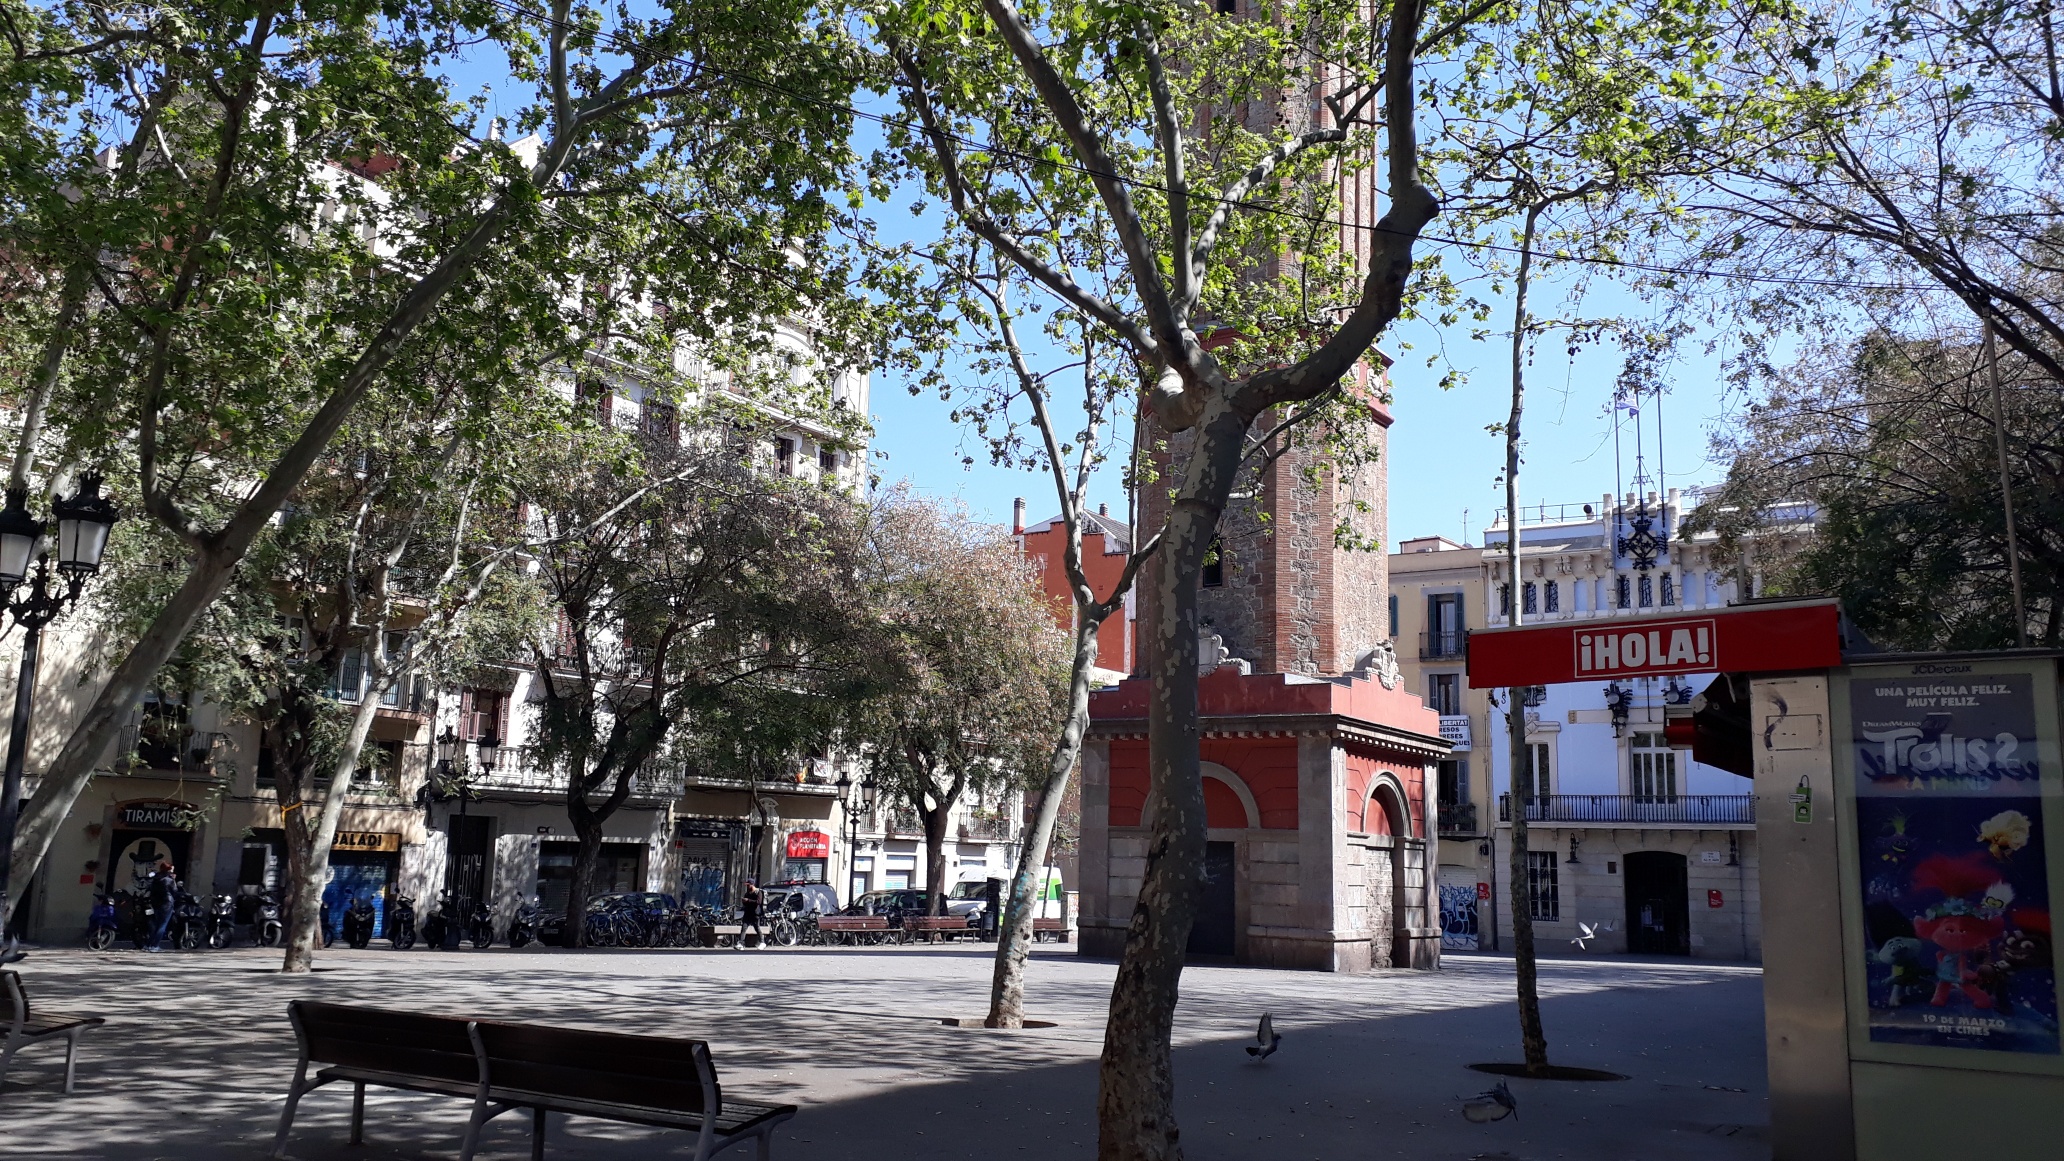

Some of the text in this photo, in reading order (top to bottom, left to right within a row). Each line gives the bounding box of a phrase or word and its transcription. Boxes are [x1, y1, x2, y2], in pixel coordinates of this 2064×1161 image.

[1580, 627, 1710, 671] ¡HOLA!
[1911, 665, 1972, 675] JCDecaux
[1875, 684, 2012, 697] UNA PELÍCULA FELIZ.
[1906, 697, 1980, 708] MUY FELIZ.
[1862, 727, 2021, 775] Trolls 2
[125, 809, 181, 824] TIRAMIS
[1922, 1014, 2006, 1029] 19 DE MARZO
[1936, 1025, 1991, 1036] EN CINES
